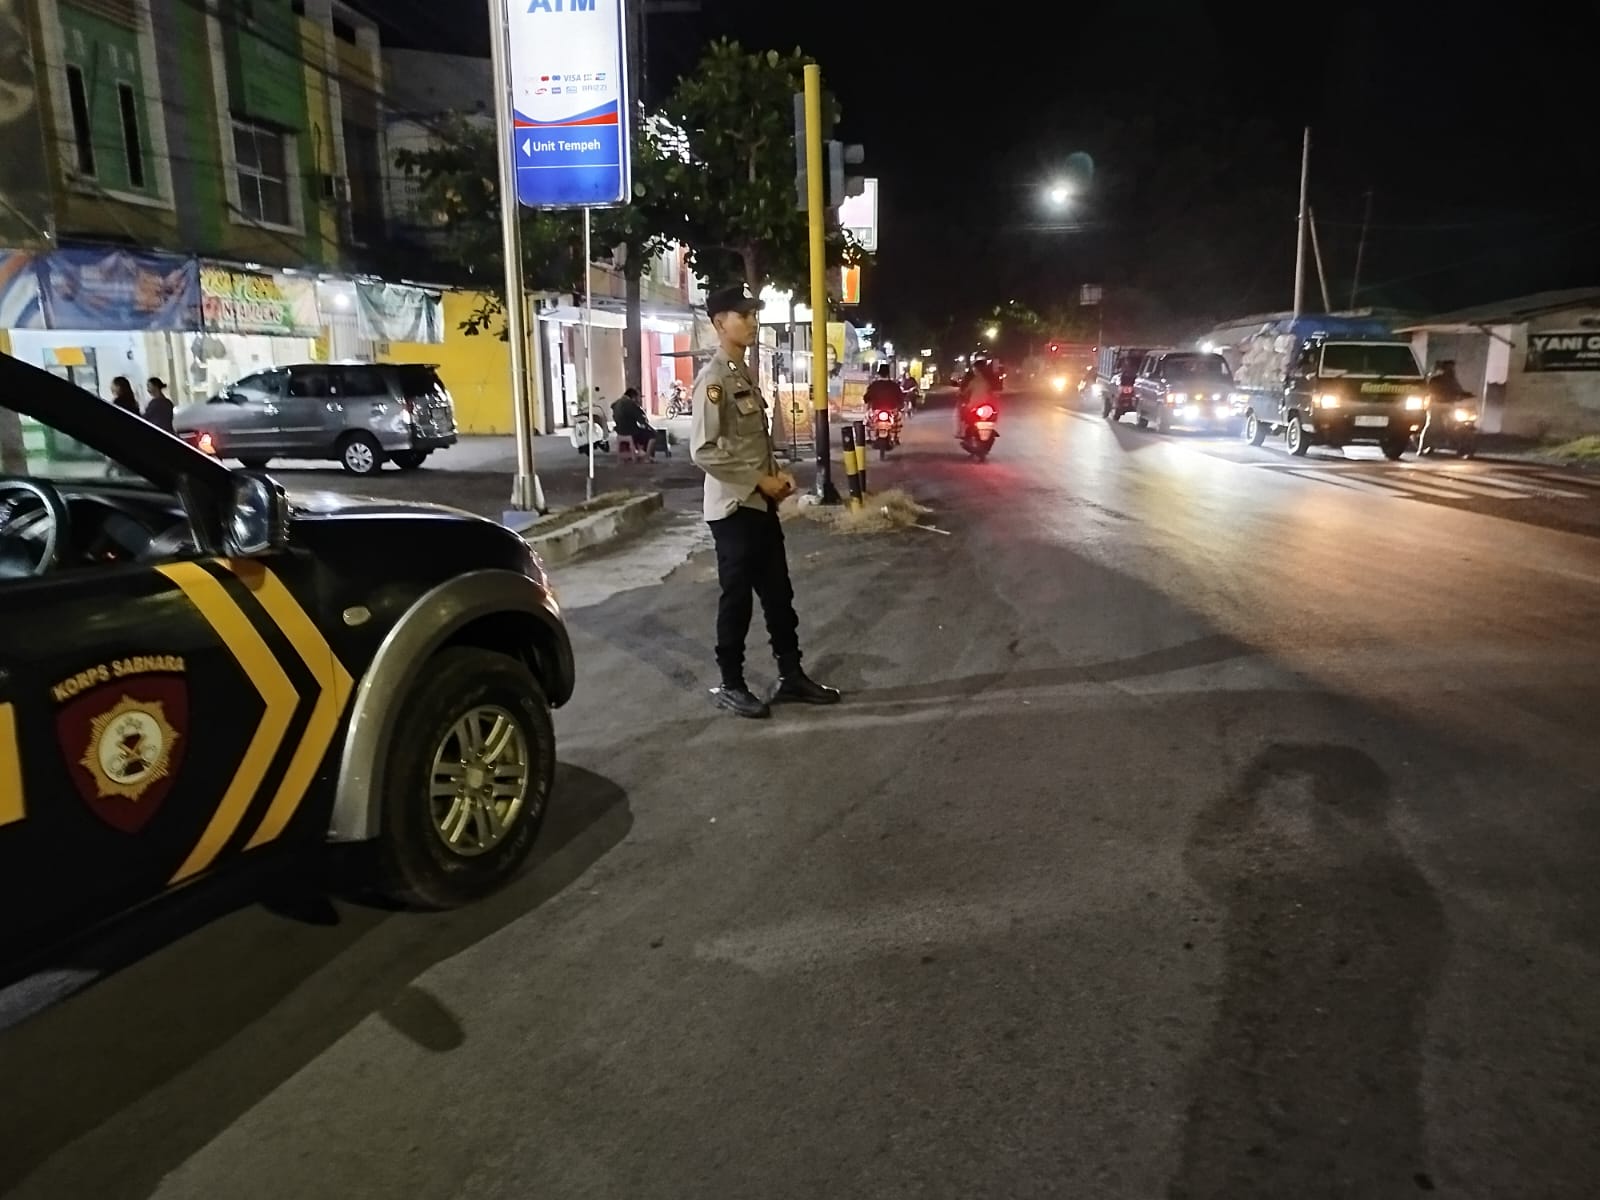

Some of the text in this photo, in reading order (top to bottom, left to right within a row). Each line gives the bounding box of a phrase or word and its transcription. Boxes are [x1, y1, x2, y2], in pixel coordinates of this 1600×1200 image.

[532, 138, 601, 153] Unit Tempeh
[1532, 336, 1583, 352] YANI
[51, 663, 110, 702] KORPS
